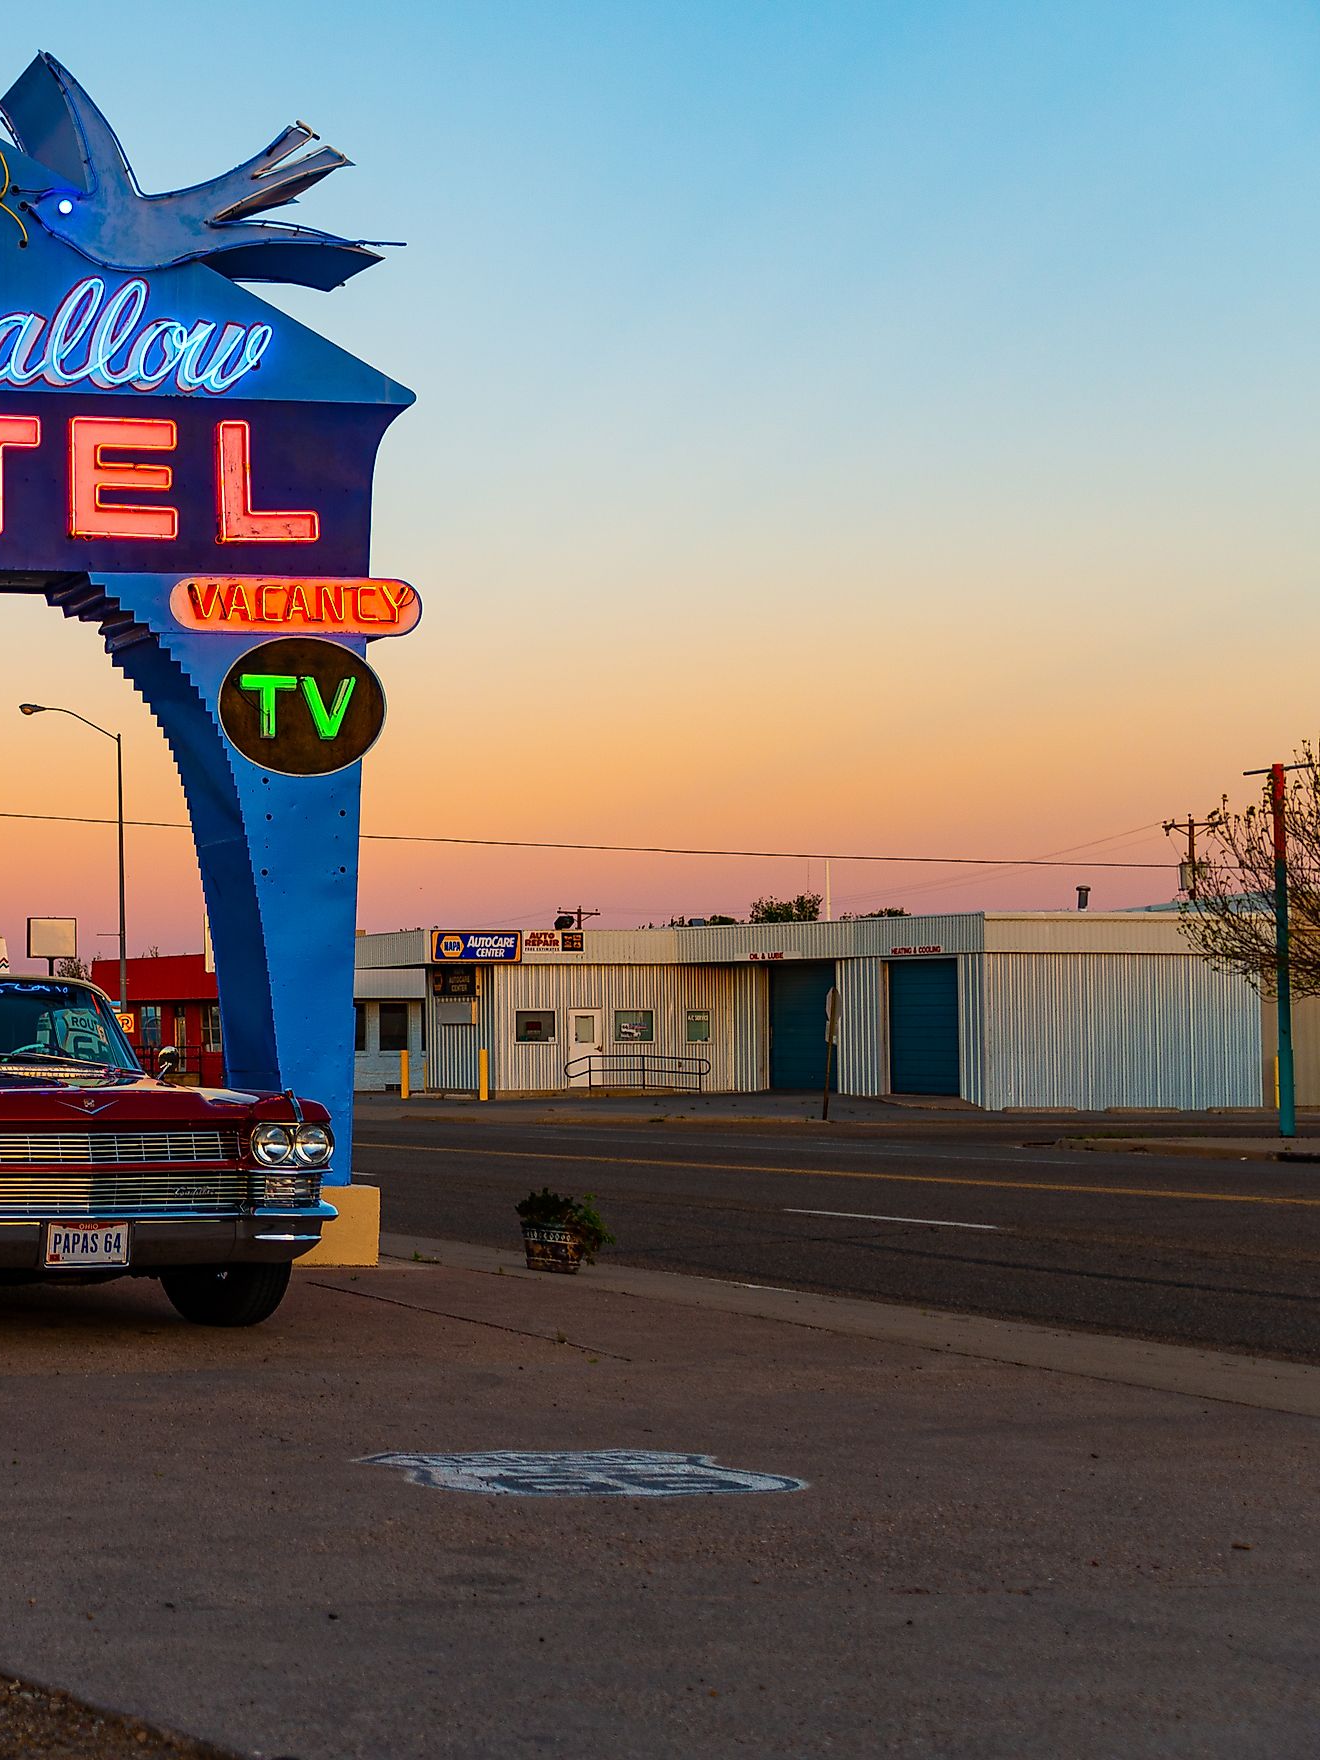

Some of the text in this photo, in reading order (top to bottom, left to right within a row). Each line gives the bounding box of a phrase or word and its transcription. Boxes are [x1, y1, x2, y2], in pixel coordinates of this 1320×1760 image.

[188, 583, 410, 624] VACANCY
[239, 673, 357, 740] TV
[443, 941, 461, 952] NAPA
[524, 939, 560, 947] REPAIR
[476, 947, 506, 958] CENTER
[918, 945, 941, 954] COOLING
[767, 952, 784, 960] LUBE
[53, 1232, 122, 1253] PAPAS 64
